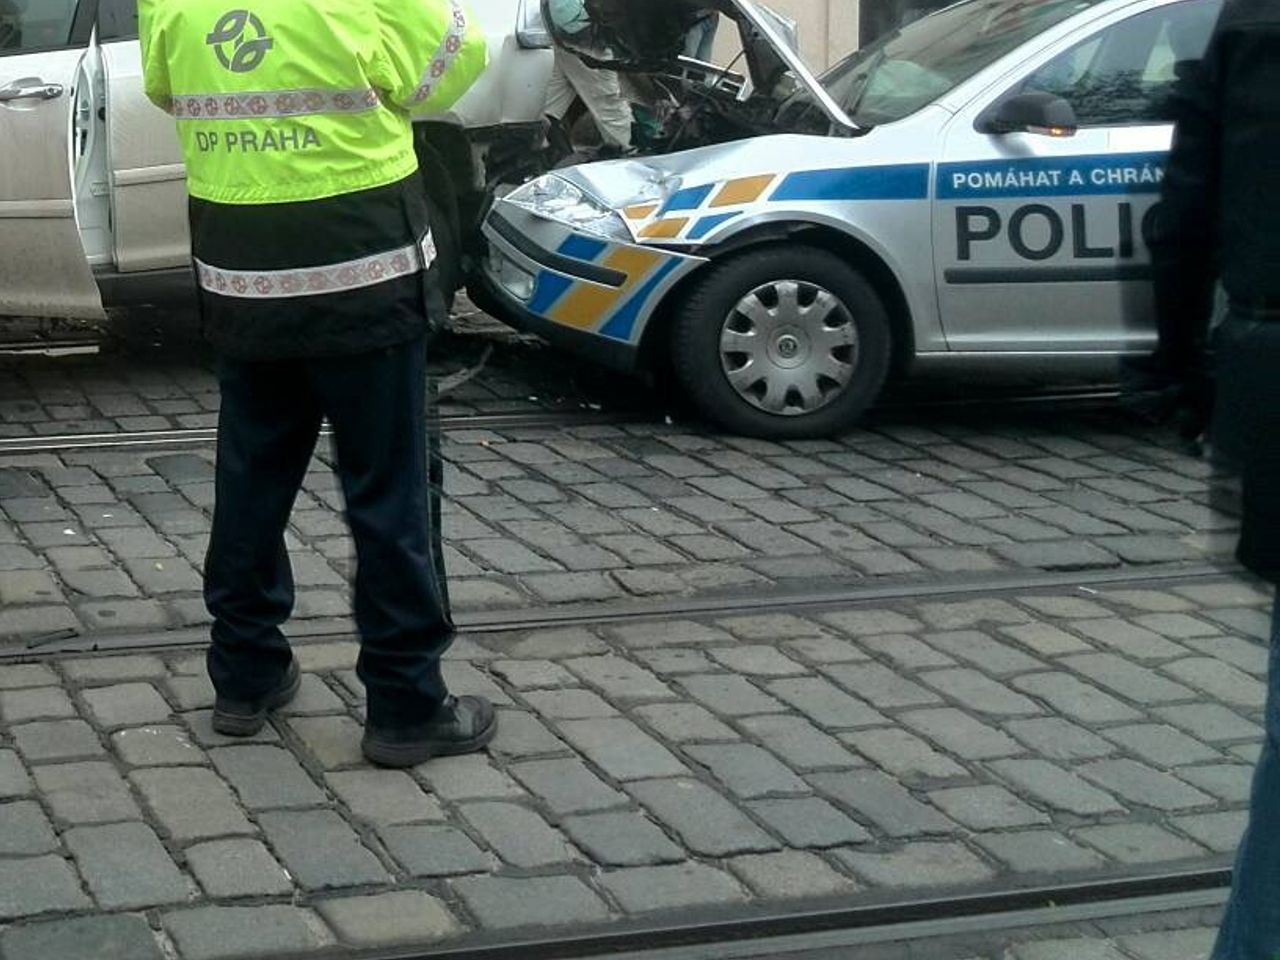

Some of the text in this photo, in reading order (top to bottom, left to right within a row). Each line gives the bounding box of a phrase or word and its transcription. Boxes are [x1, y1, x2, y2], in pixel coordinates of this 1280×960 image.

[196, 126, 322, 153] DP PRAHA
[952, 167, 1062, 188] POMÁHAT
[1069, 170, 1085, 185] A
